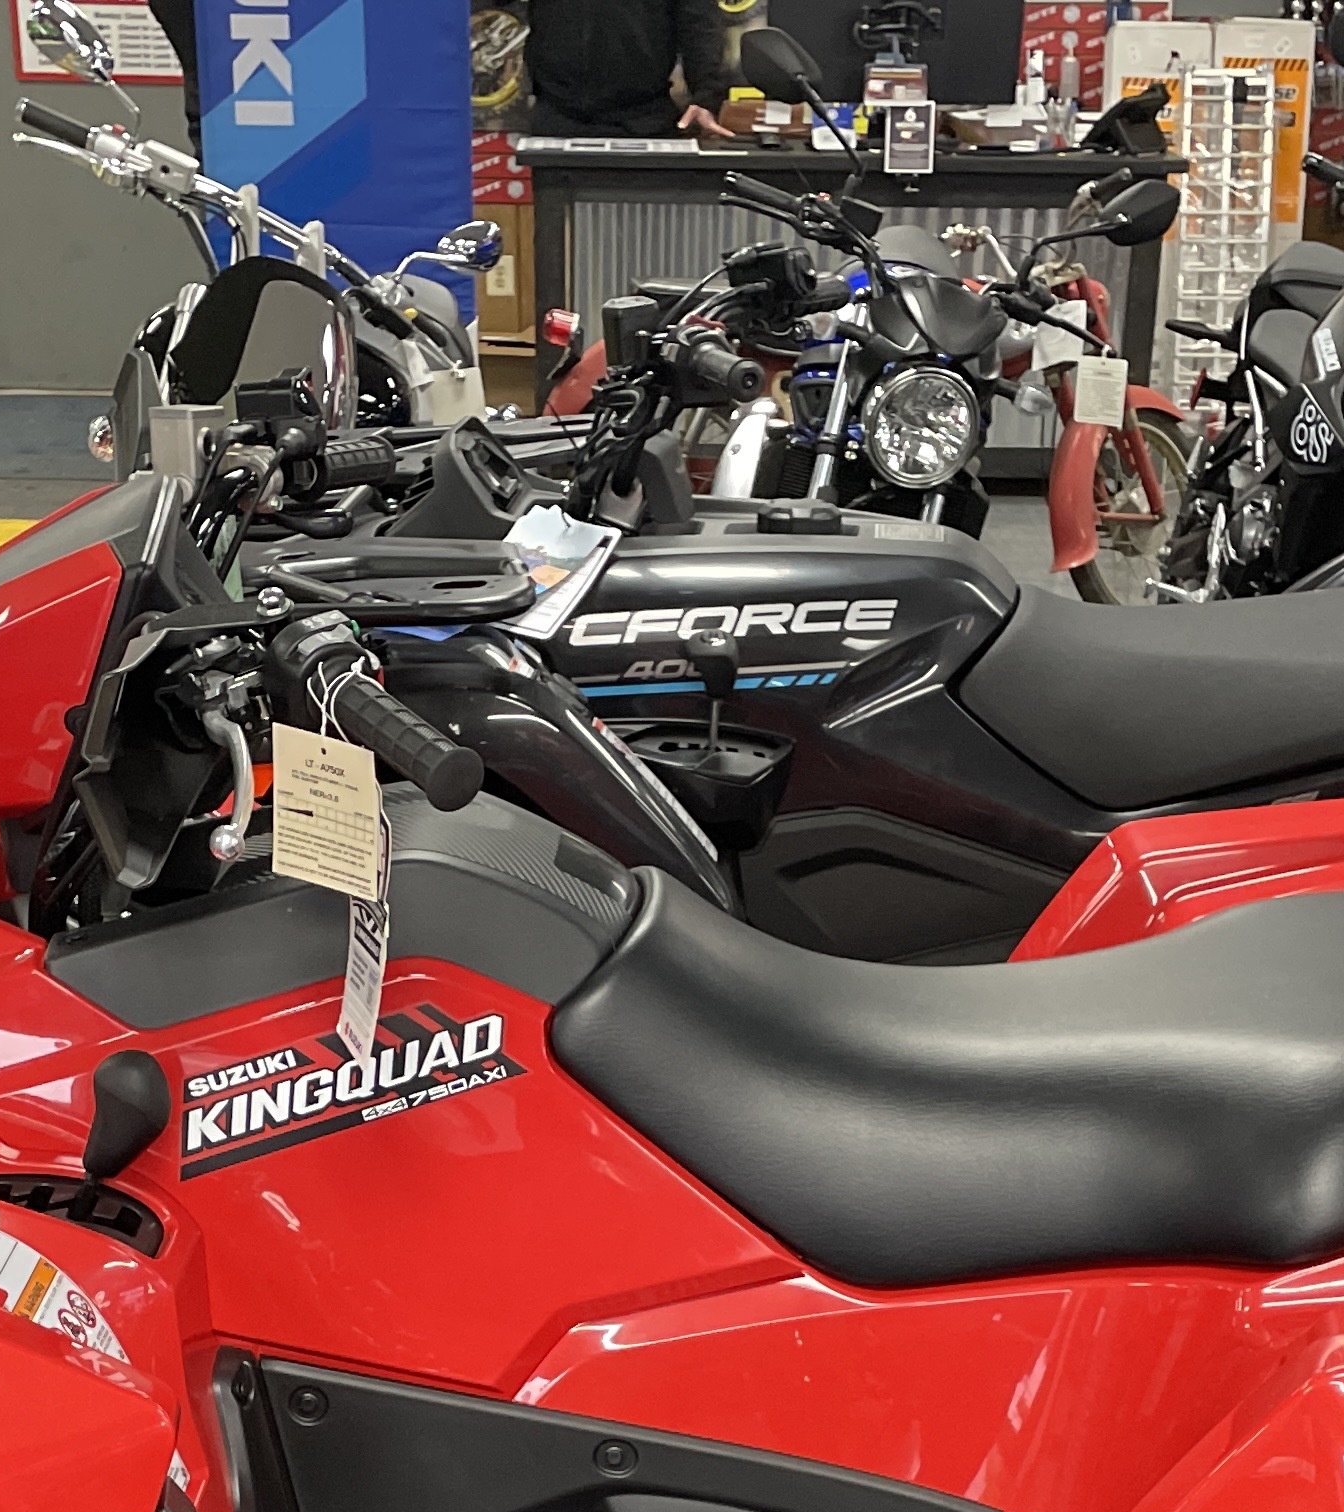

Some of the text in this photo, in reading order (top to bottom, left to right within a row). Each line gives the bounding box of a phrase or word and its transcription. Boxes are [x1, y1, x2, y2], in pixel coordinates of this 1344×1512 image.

[568, 598, 899, 647] CFORCE
[186, 1014, 504, 1152] KINGQUAD
[187, 1049, 298, 1098] SUZUKI
